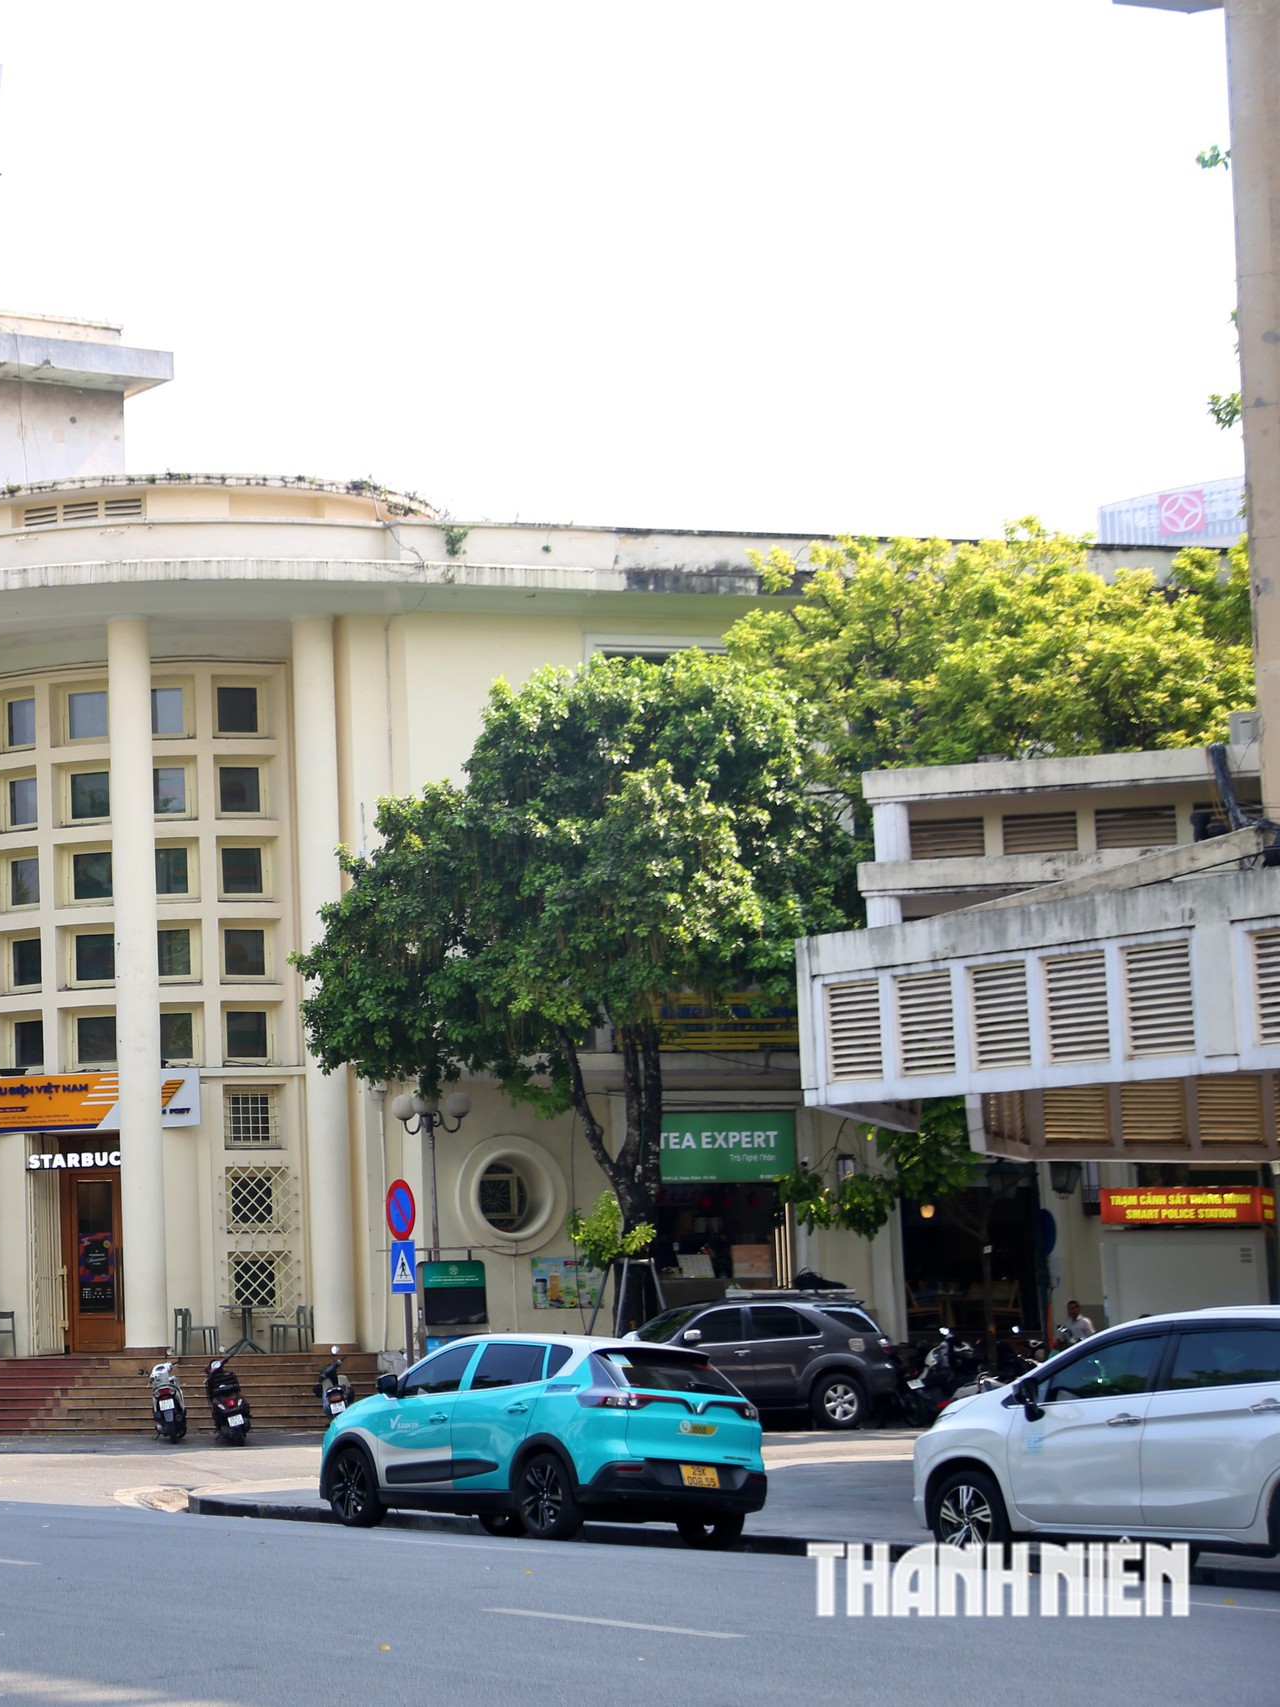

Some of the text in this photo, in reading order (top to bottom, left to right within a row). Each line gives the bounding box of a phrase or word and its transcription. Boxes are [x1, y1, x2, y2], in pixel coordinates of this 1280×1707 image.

[62, 1084, 88, 1093] NAM
[701, 1131, 778, 1149] EXPERT
[1168, 1192, 1188, 1205] SÁT
[1125, 1207, 1237, 1220] SMART POLICE STATION
